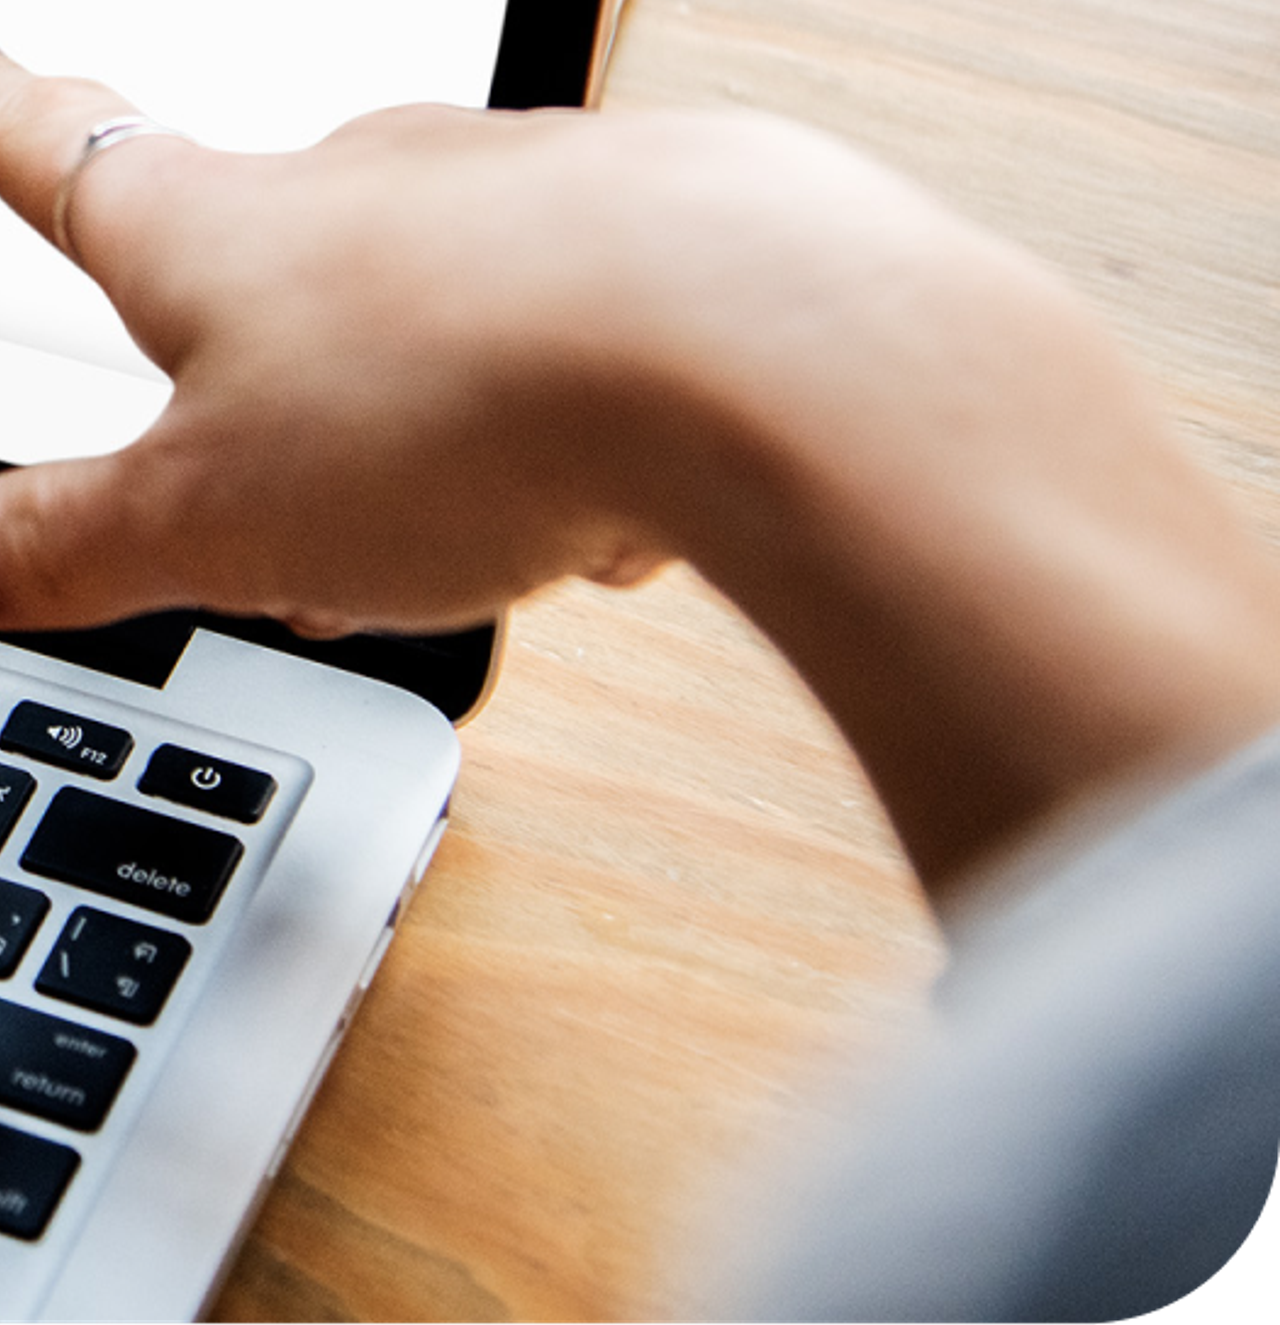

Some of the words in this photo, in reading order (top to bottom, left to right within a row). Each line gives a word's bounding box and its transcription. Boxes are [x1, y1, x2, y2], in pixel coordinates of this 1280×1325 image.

[80, 745, 107, 766] F12
[116, 862, 191, 897] delete
[54, 1032, 107, 1060] enter
[13, 1067, 87, 1106] return
